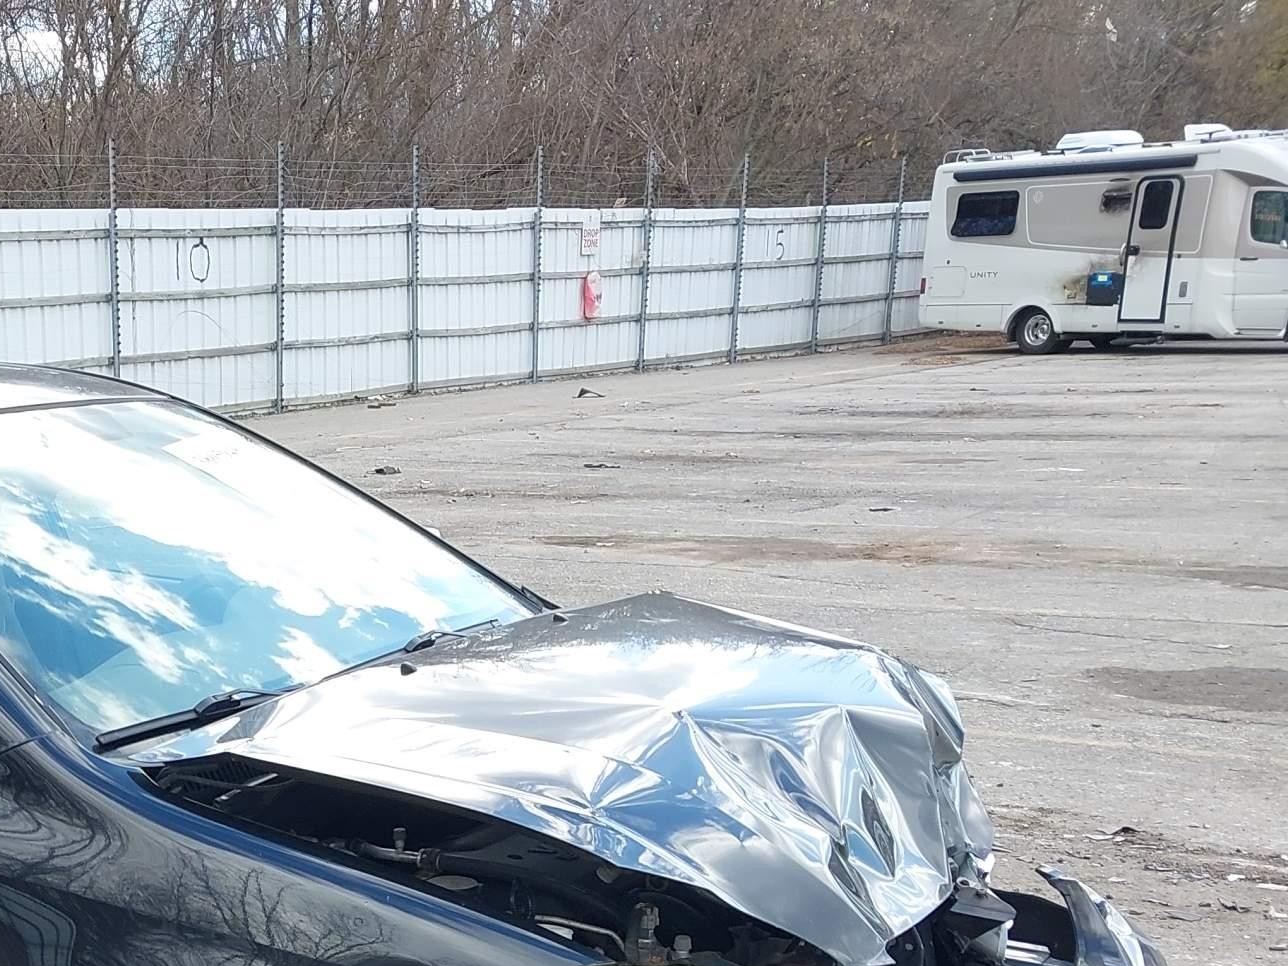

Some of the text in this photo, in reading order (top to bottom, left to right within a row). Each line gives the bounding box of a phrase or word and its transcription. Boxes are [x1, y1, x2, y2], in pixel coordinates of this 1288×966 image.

[583, 228, 599, 238] DROP
[583, 238, 599, 248] ZONE
[765, 229, 785, 261] 15
[175, 238, 211, 283] 10
[969, 271, 999, 279] UNITY
